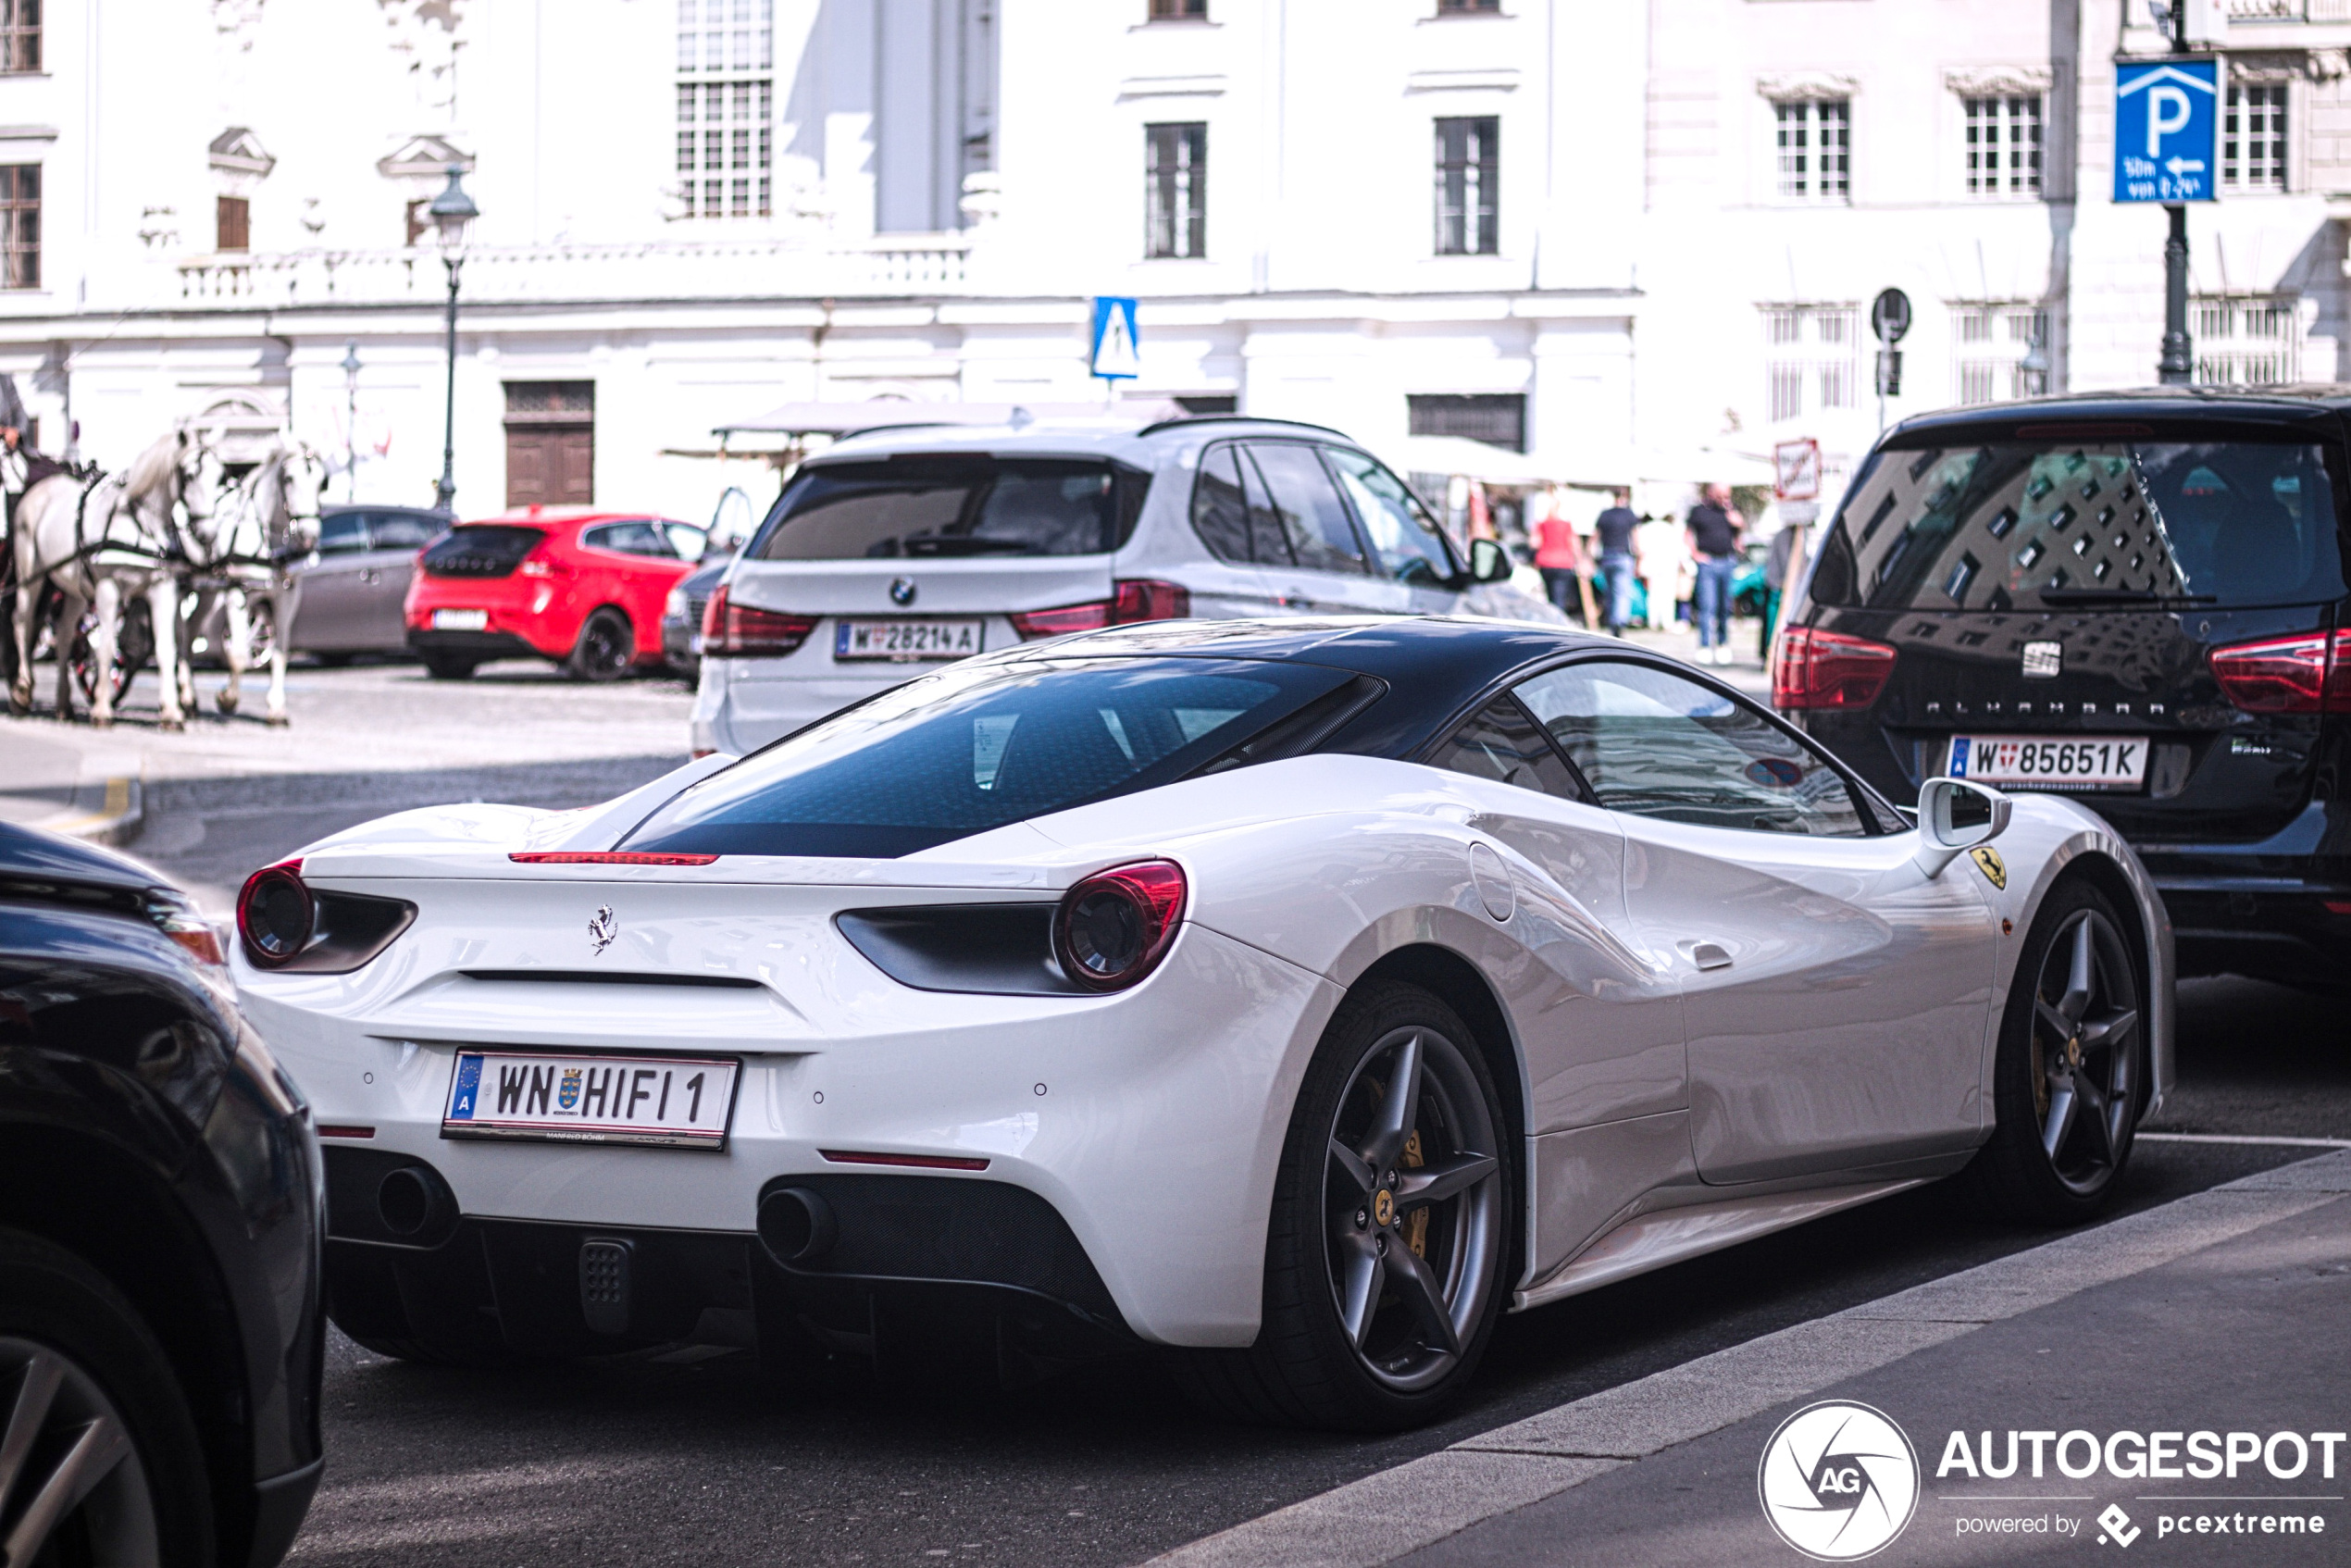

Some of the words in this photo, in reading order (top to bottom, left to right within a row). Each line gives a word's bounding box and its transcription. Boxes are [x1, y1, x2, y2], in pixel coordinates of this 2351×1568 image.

[2146, 85, 2192, 158] P
[855, 627, 871, 649] W
[1927, 701, 2165, 715] ALHAMBRA
[1977, 742, 1998, 774] W
[497, 1064, 555, 1115] WN
[458, 1095, 470, 1111] A
[546, 1132, 581, 1140] MANFRED
